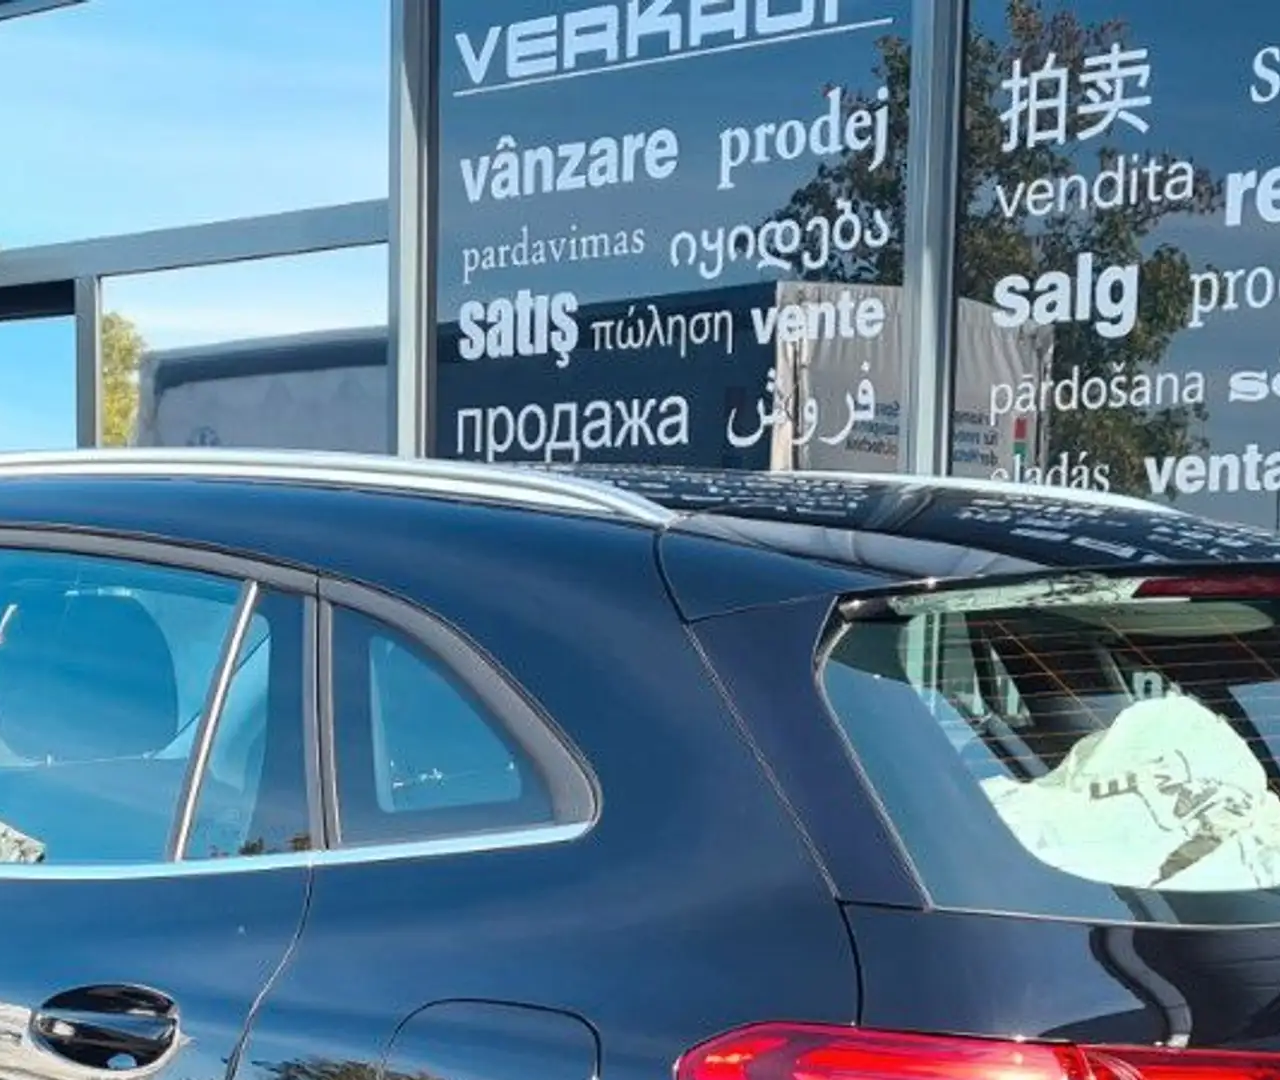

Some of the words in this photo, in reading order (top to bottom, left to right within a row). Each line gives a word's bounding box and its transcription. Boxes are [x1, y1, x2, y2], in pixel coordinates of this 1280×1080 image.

[998, 42, 1152, 153] 拍卖
[460, 127, 679, 203] vânzare
[717, 87, 889, 190] prodej
[995, 154, 1194, 218] vendita
[462, 222, 646, 285] pardavimas
[670, 198, 890, 280] იყიდება
[457, 289, 579, 368] satış
[591, 304, 733, 358] πώληση
[750, 289, 887, 345] vente
[991, 252, 1139, 339] salg
[456, 394, 690, 462] продажа
[726, 362, 877, 448] فروش
[989, 361, 1205, 425] pārdošana
